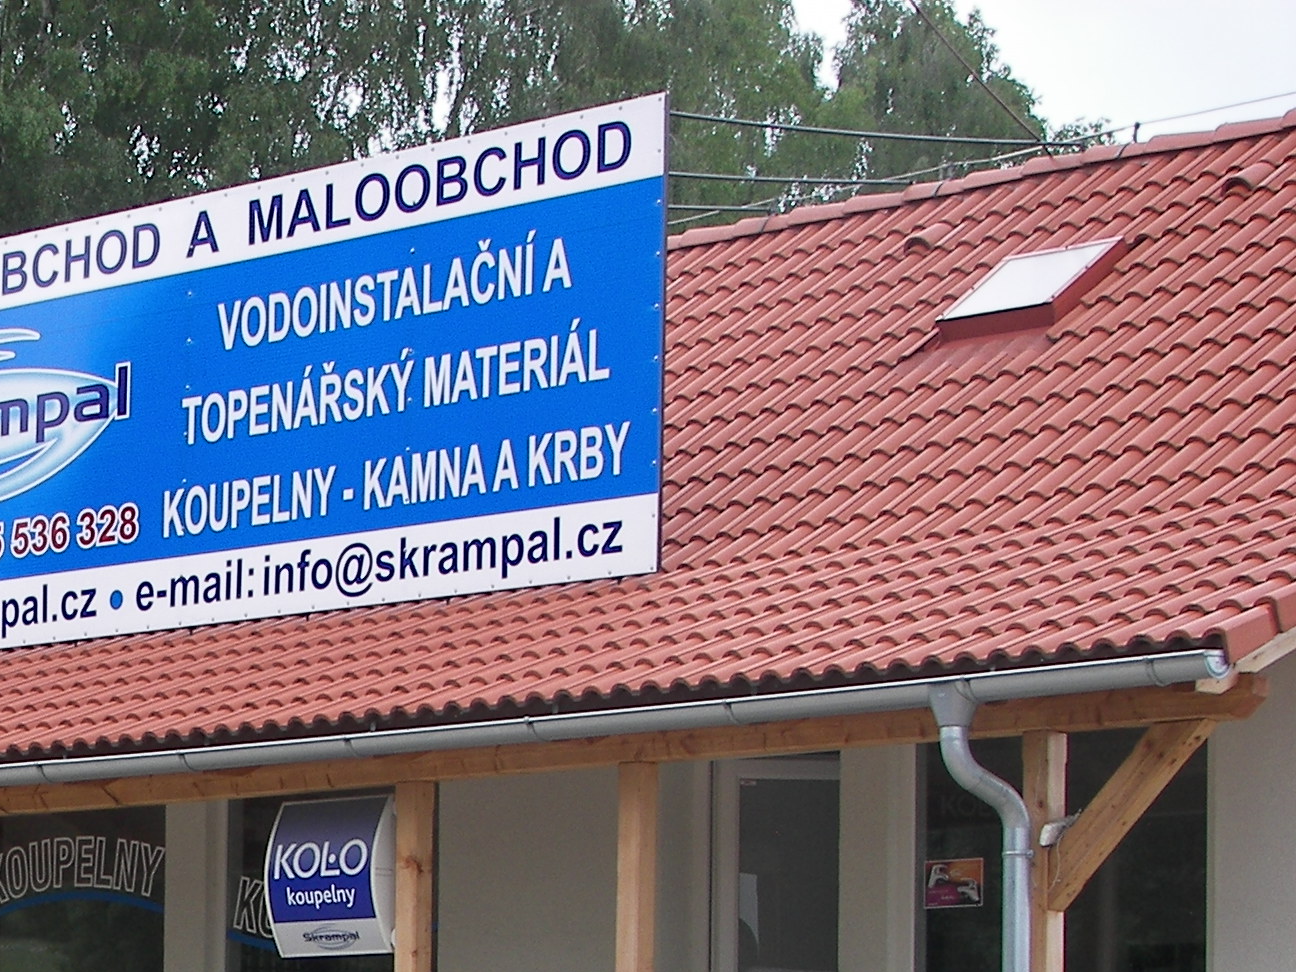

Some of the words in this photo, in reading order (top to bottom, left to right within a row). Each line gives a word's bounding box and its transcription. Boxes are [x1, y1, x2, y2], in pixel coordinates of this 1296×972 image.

[186, 210, 220, 258] A
[248, 121, 632, 245] MALOOBCHOD
[217, 229, 537, 351] VODOINSTALAČNÍ
[542, 237, 572, 292] A
[182, 347, 415, 445] TOPENÁŘSKÝ
[423, 317, 611, 408] MATERIÁL
[11, 511, 71, 560] 536
[76, 502, 140, 550] 328
[162, 465, 336, 538] KOUPELNY
[363, 444, 485, 510] KAMNA
[491, 440, 516, 493] A
[527, 422, 631, 488] KRBY
[286, 884, 355, 909] koupelny
[302, 930, 360, 942] Skrampal
